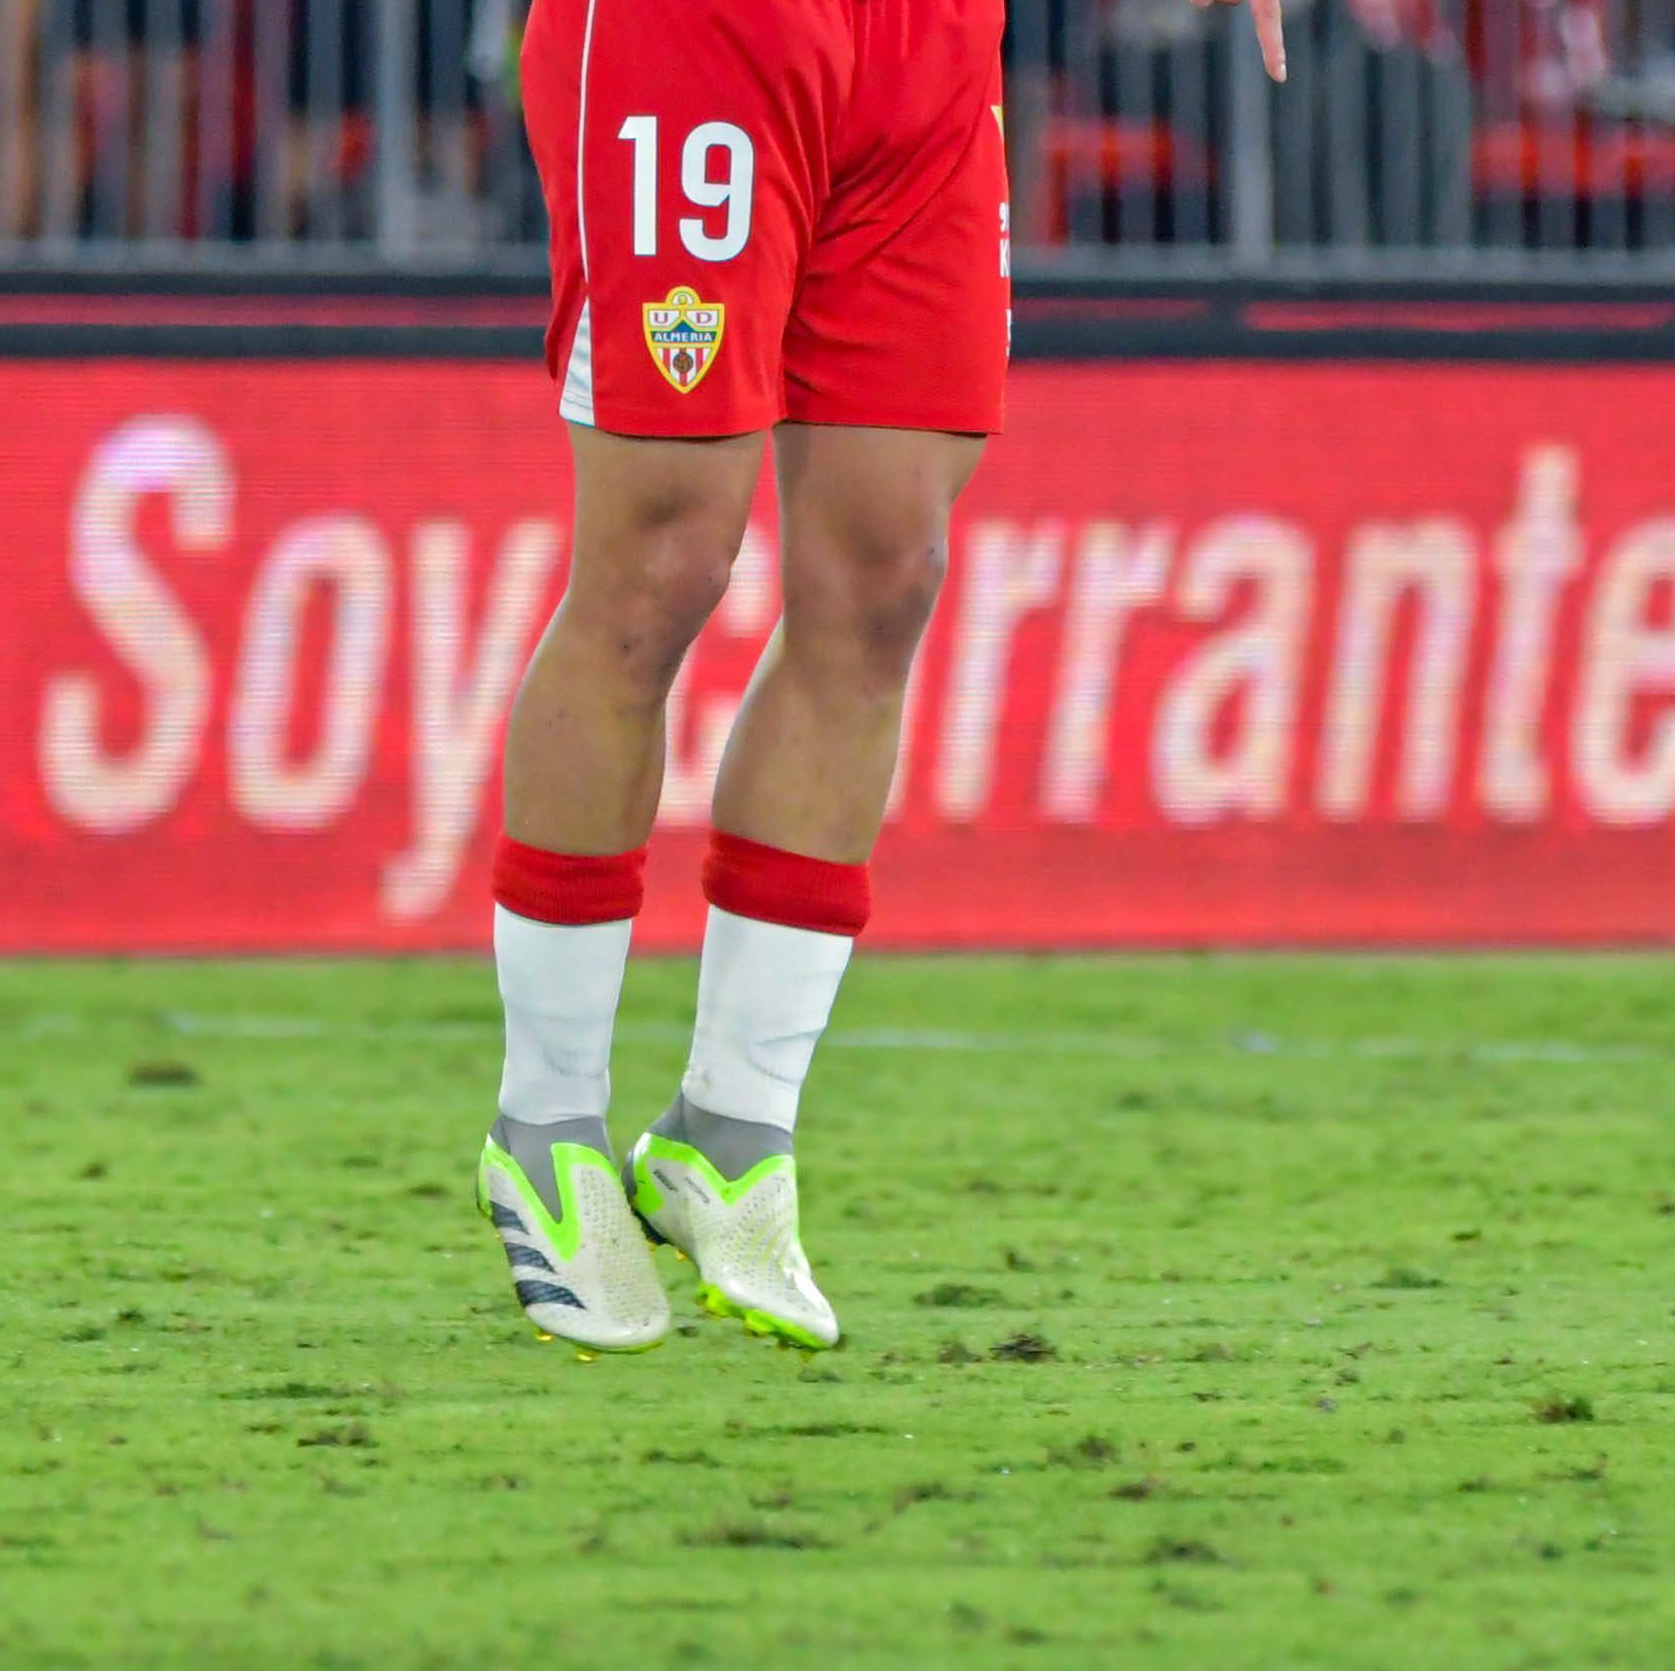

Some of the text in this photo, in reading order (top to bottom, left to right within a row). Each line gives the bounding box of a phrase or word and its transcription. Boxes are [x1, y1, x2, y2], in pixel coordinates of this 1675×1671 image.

[617, 115, 755, 262] 19
[653, 331, 713, 343] ALMERIA
[38, 415, 564, 925] Soy
